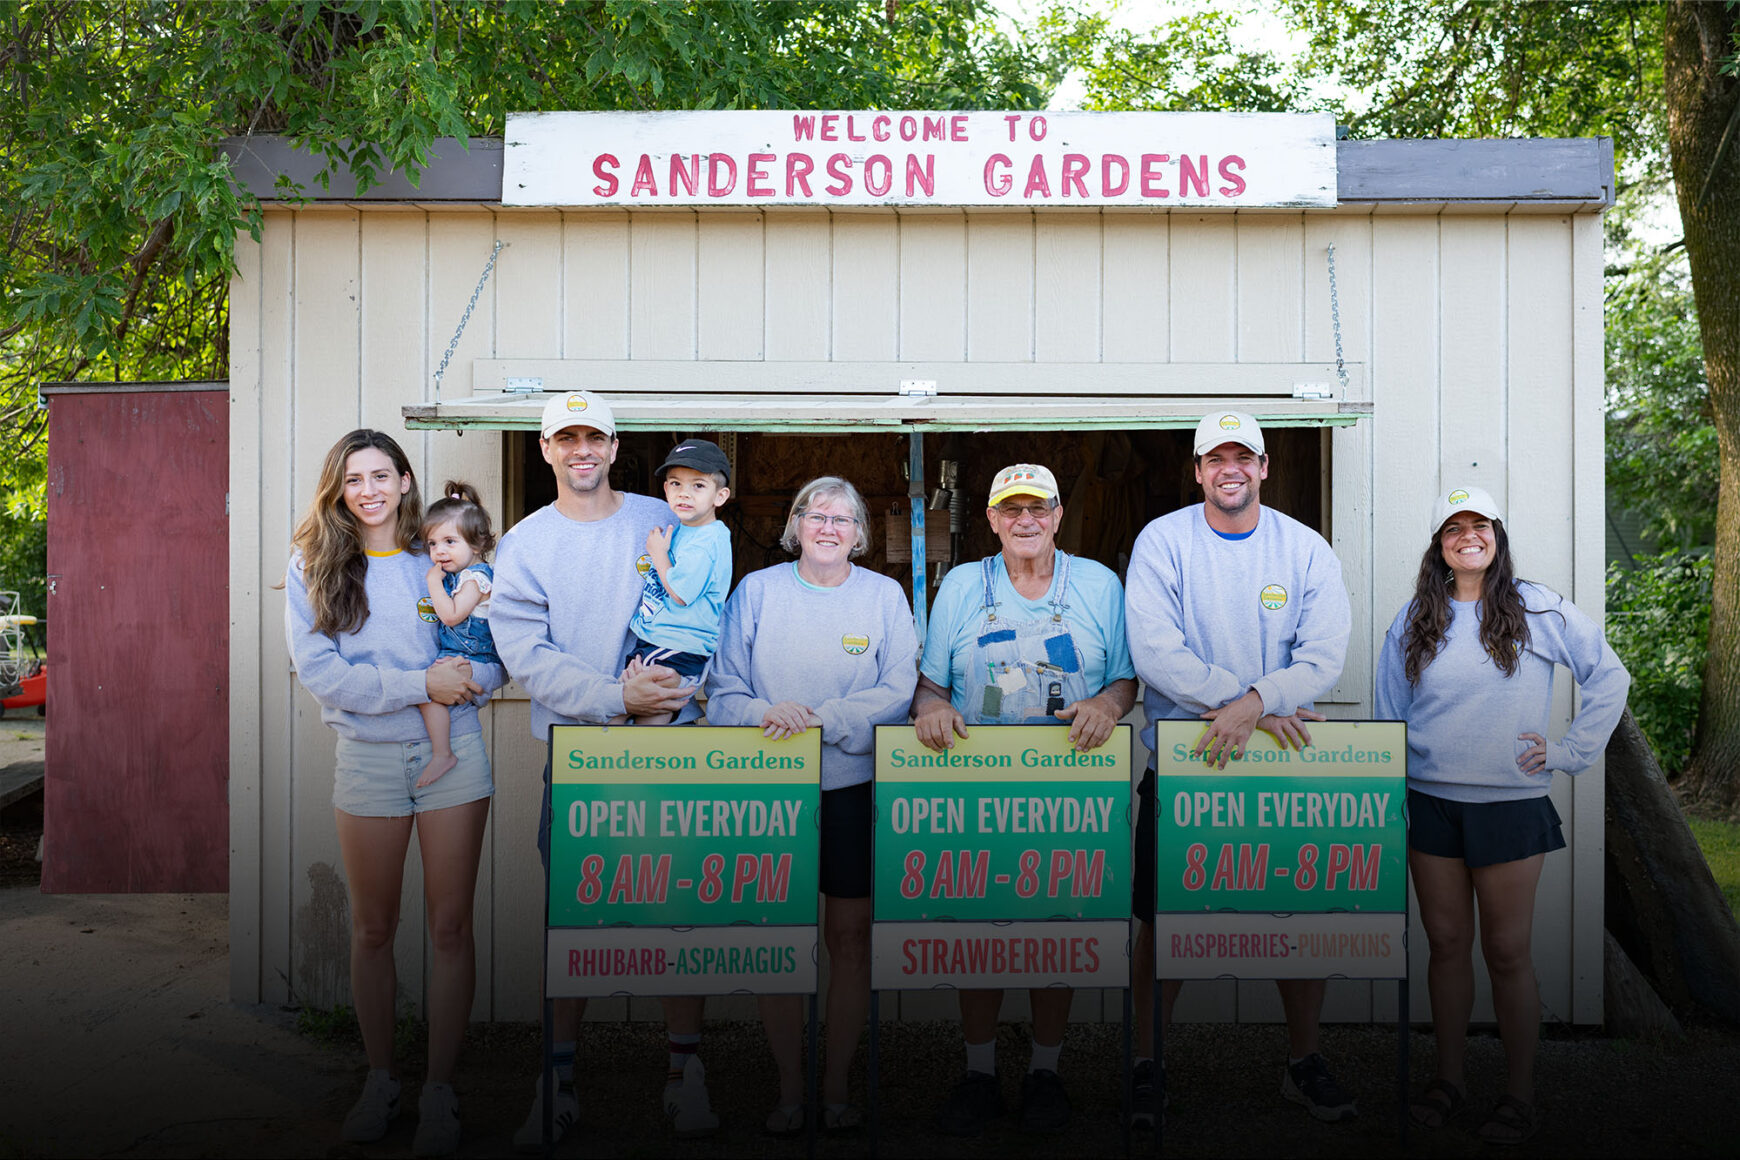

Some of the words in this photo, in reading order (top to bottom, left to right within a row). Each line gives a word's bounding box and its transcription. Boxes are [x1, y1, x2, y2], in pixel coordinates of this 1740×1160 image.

[793, 114, 969, 141] WELCOME
[1004, 115, 1047, 141] TO
[592, 153, 935, 197] SANDERSON
[984, 153, 1246, 198] GARDENS
[568, 749, 696, 769] Sanderson
[706, 750, 805, 769] Gardens
[890, 748, 1011, 768] Sanderson
[1021, 748, 1116, 768] Gardens
[1300, 744, 1392, 764] Gardens
[568, 801, 645, 837] OPEN
[660, 800, 803, 837] EVERYDAY
[891, 798, 964, 834] OPEN
[978, 797, 1114, 833] EVERYDAY
[1174, 792, 1245, 827] OPEN
[1258, 792, 1390, 828] EVERYDAY
[731, 854, 792, 903] PM
[1047, 850, 1105, 897] PM
[1325, 844, 1382, 891] PM
[902, 937, 1100, 975] STRAWBERRIES
